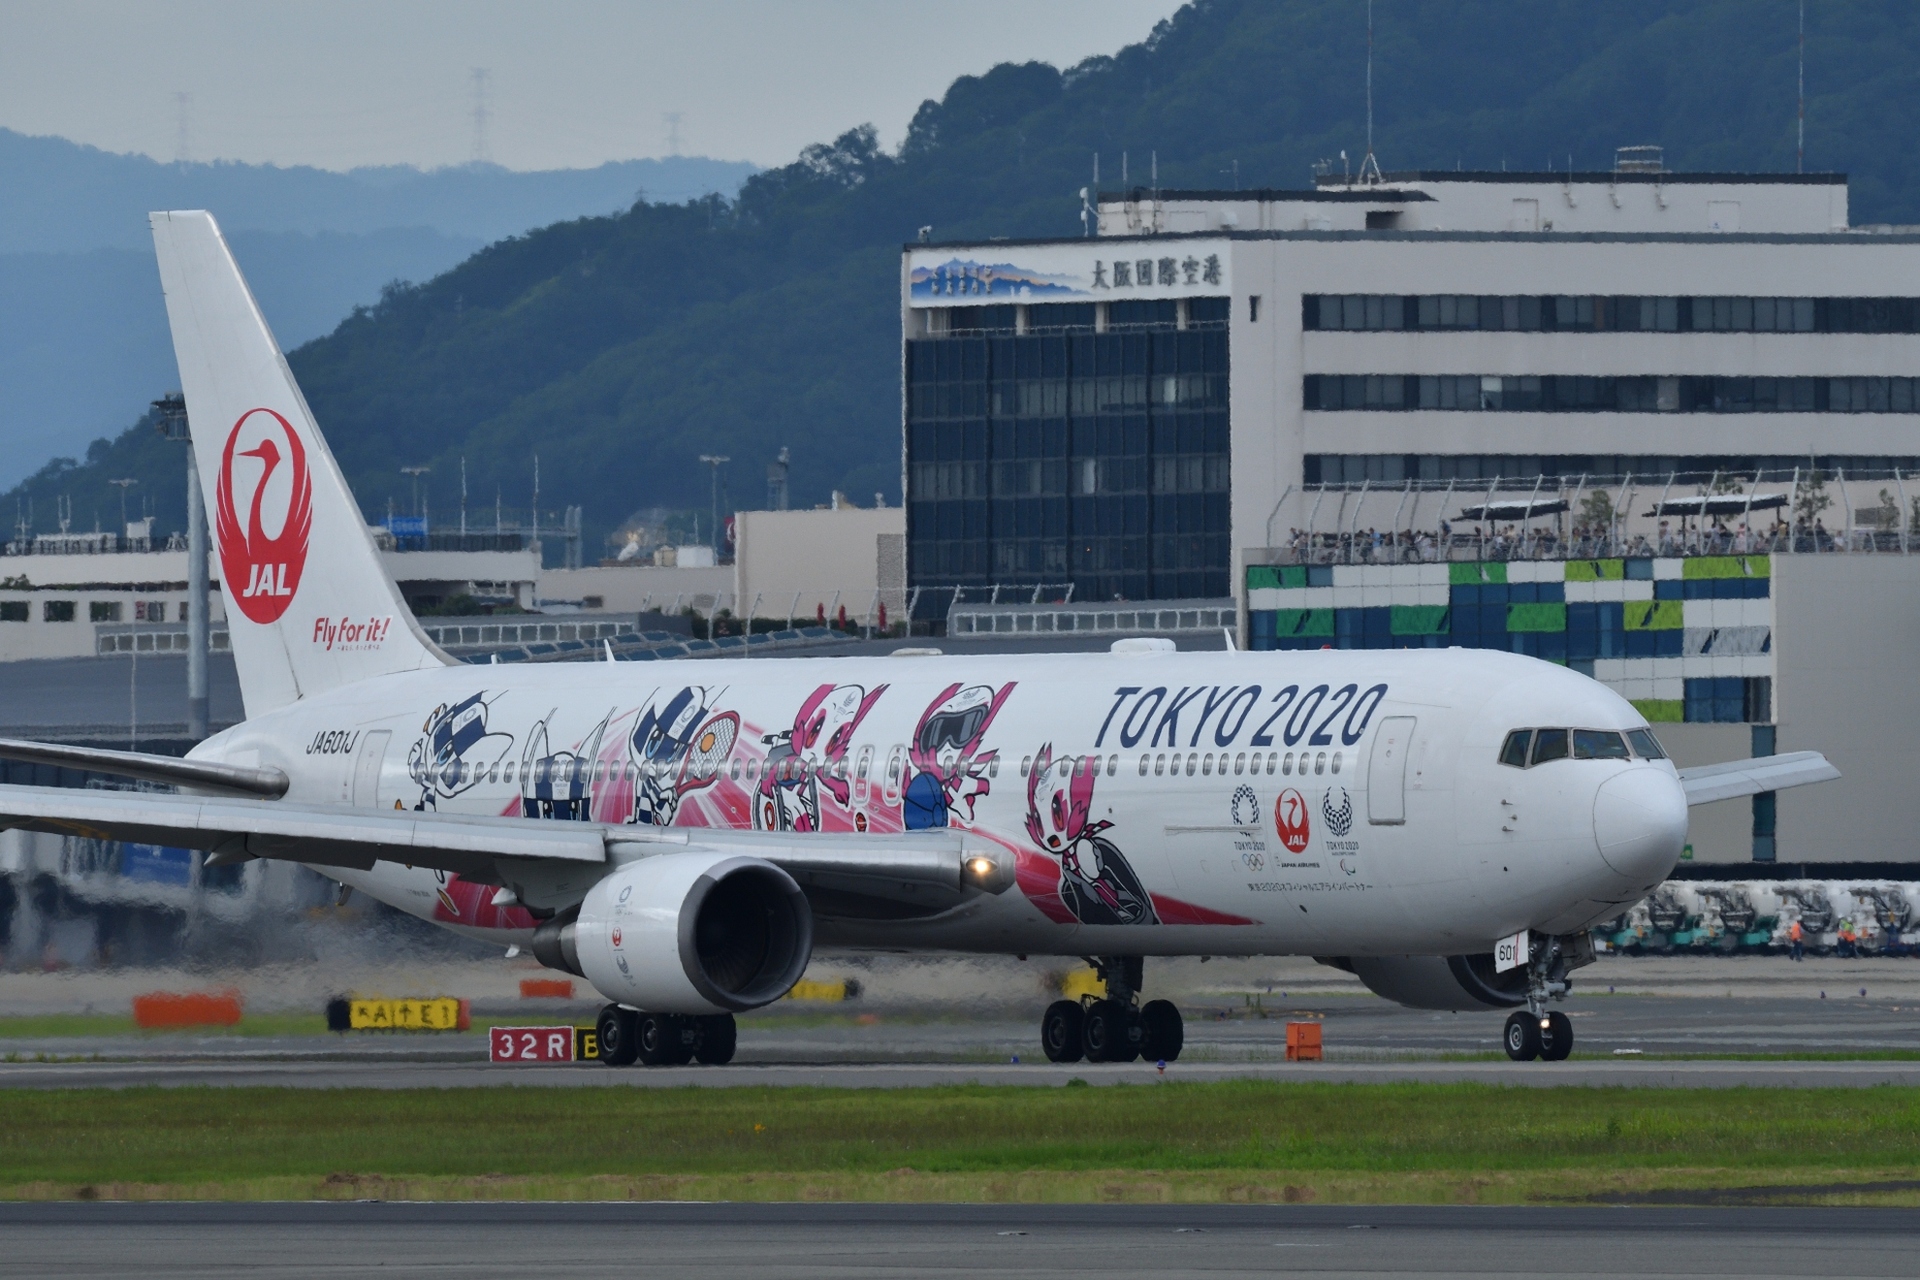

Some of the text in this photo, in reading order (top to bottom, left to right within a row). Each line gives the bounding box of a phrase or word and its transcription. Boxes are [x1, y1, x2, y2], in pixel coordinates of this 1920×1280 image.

[1091, 253, 1222, 289] 大阪国際空港
[242, 563, 292, 597] JAL
[313, 617, 391, 651] Fly for it!
[1094, 684, 1388, 748] TOKYO 2020
[306, 730, 360, 754] JA601J
[1234, 841, 1266, 851] TOKYO 2020
[1287, 834, 1306, 846] JAL
[1326, 841, 1360, 851] TOKYO 2020
[1499, 945, 1516, 961] 601
